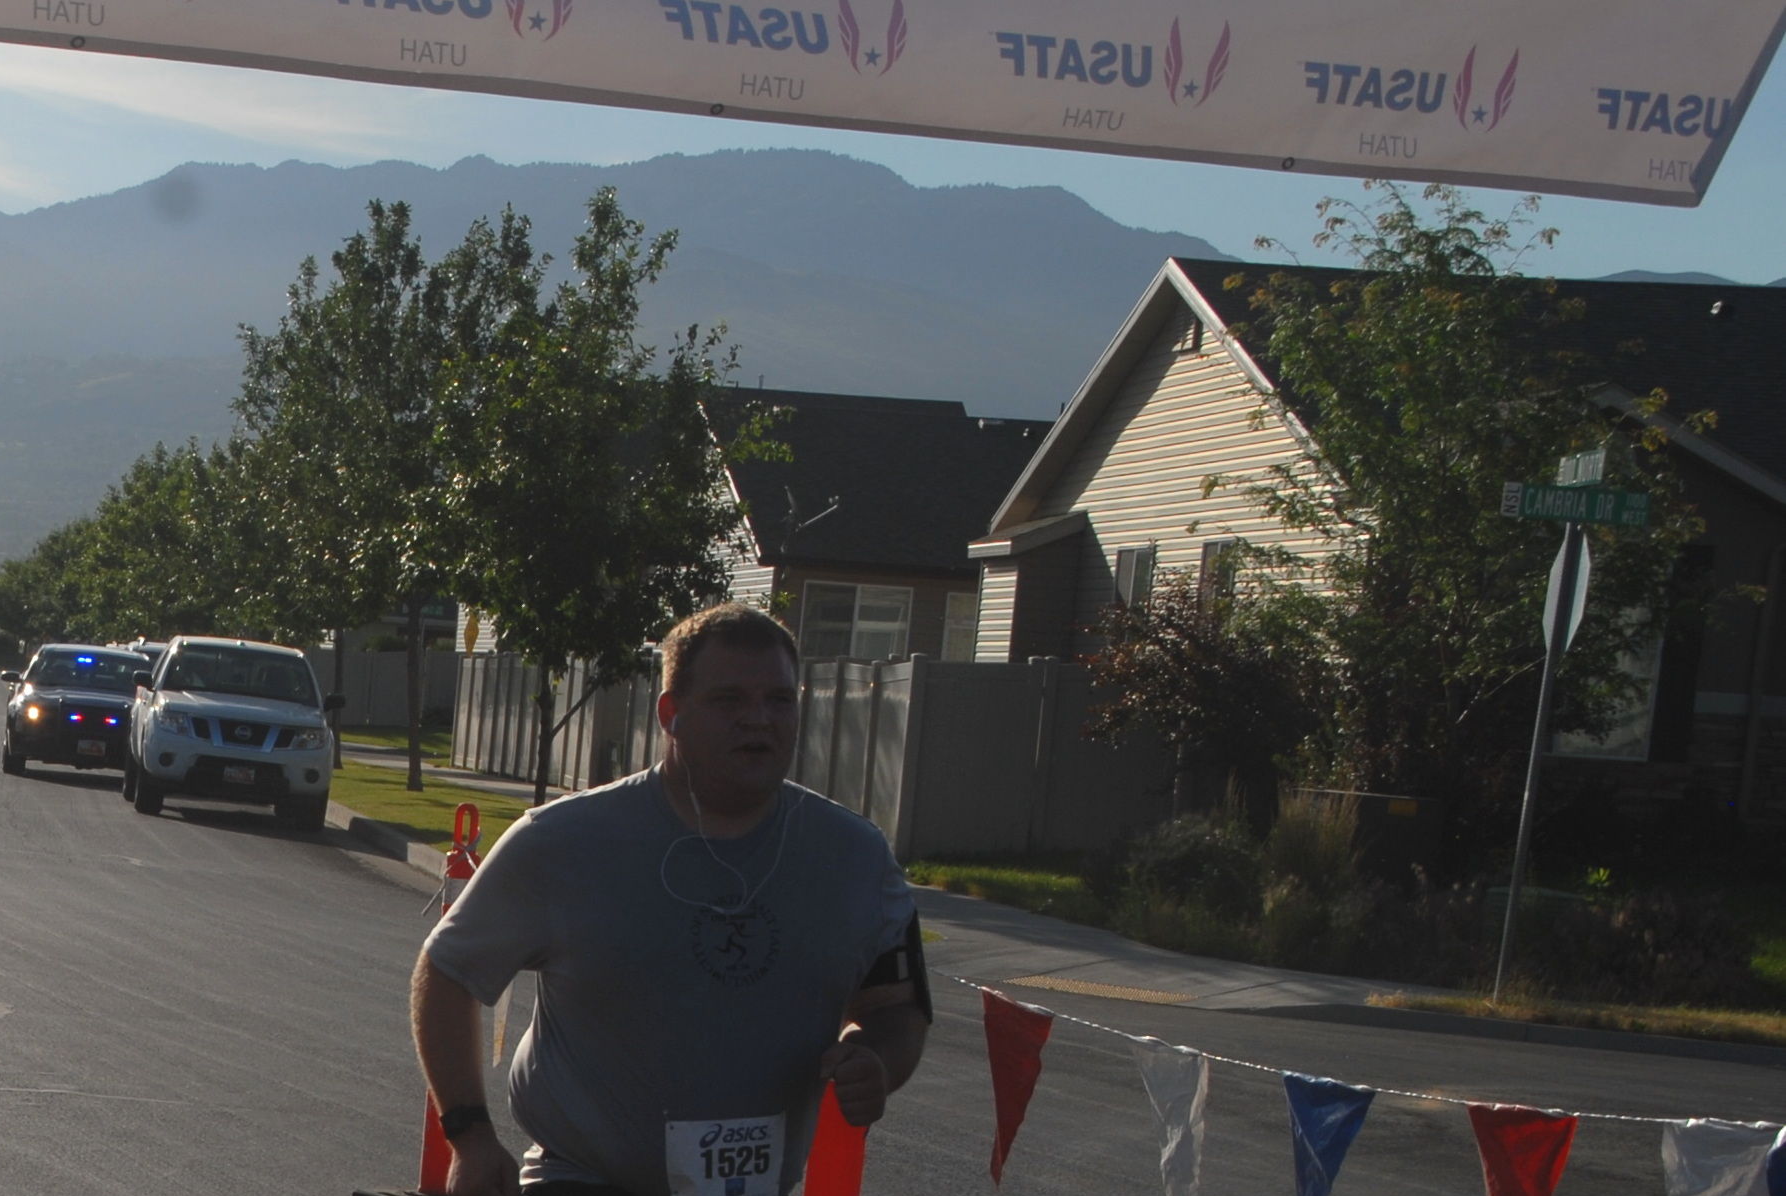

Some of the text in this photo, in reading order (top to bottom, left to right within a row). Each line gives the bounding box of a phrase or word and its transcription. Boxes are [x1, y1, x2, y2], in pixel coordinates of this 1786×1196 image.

[1504, 485, 1520, 514] NSL
[1523, 488, 1614, 520] CAMBRIA DR
[1621, 510, 1648, 525] WEST
[700, 1144, 771, 1179] 1525
